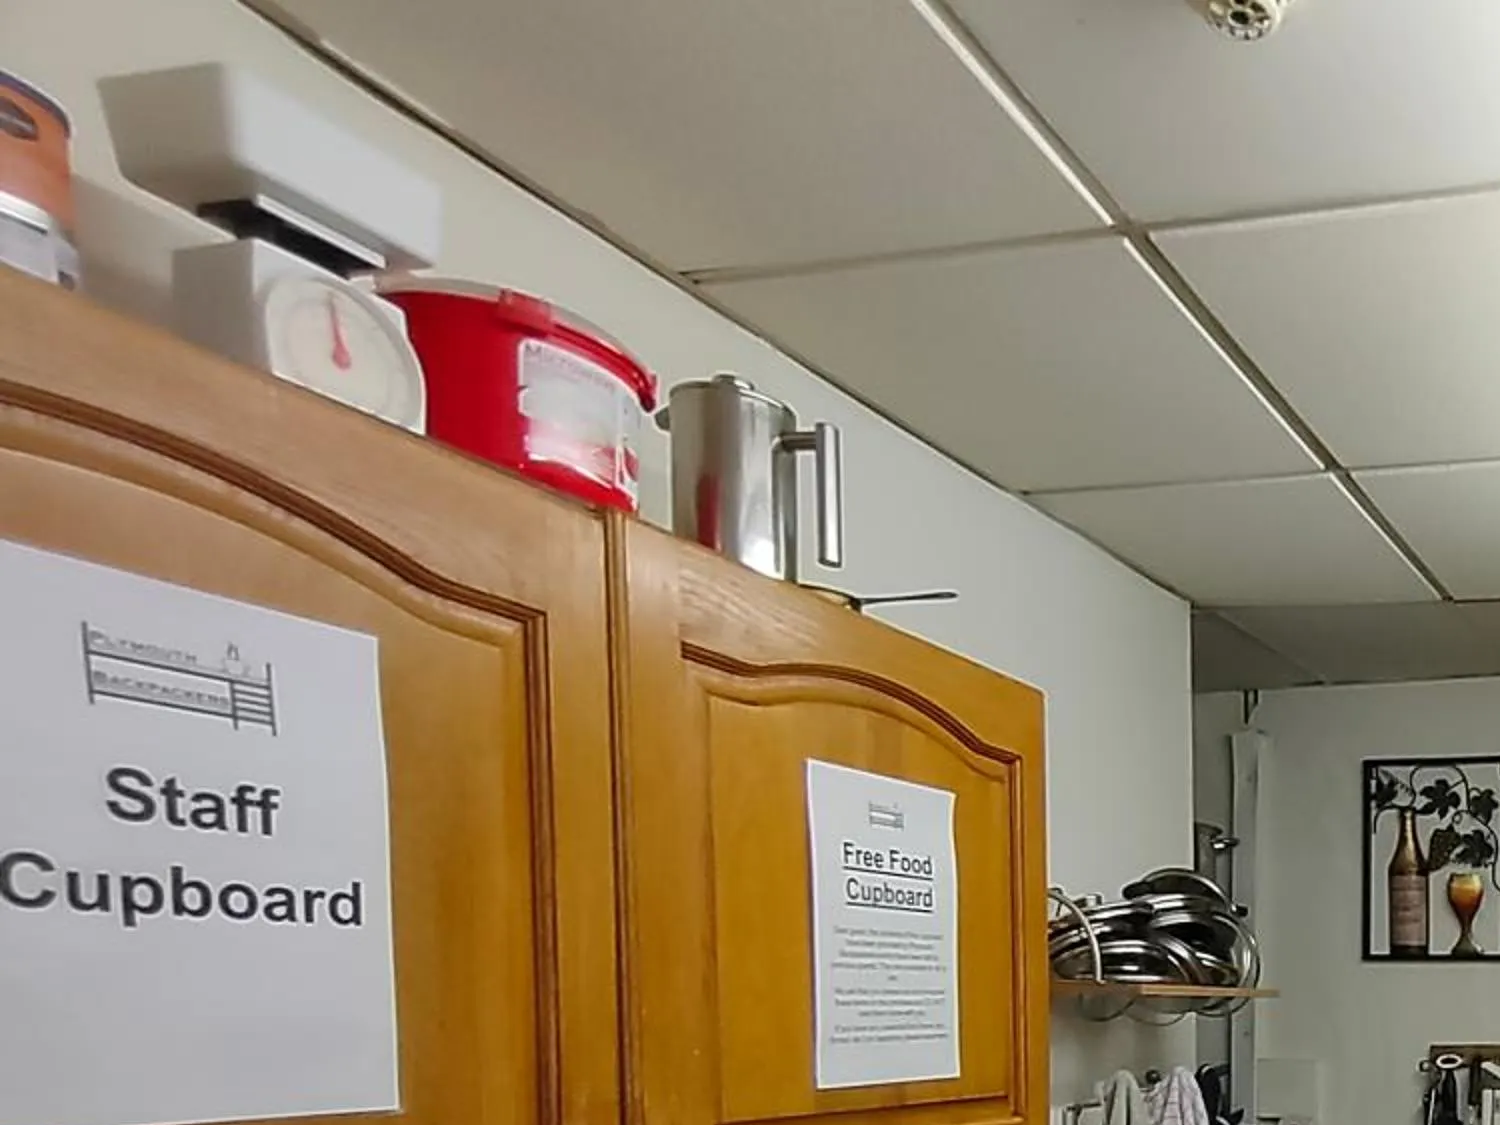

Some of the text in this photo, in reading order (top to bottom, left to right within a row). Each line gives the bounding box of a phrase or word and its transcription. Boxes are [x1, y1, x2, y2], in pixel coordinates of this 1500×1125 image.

[105, 766, 281, 836] Staff
[843, 841, 933, 876] Free Food
[0, 851, 362, 928] Cupboard
[846, 877, 933, 908] Cupboard
